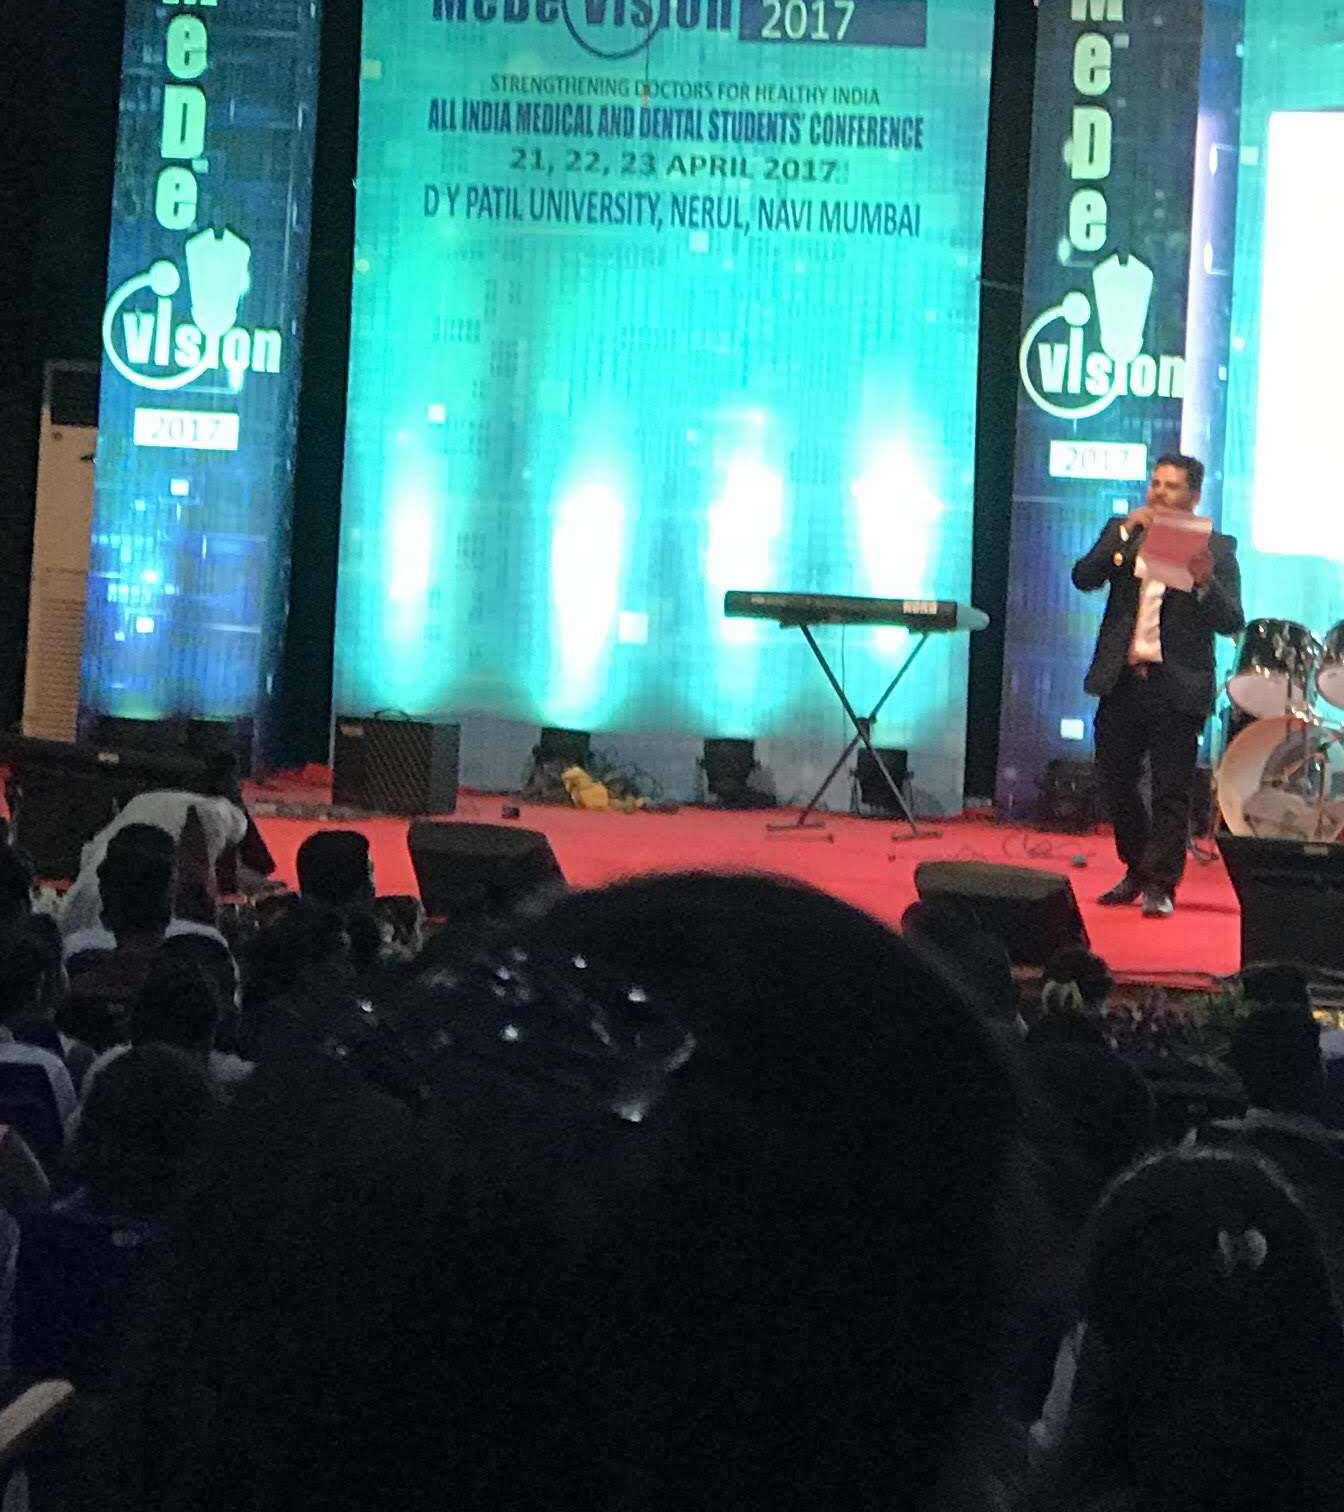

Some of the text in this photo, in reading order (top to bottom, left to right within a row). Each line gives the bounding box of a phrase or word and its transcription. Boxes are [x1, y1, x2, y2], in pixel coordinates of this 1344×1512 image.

[491, 73, 881, 107] STRENGTHENING DOCTORS FOR HEALTHY INDIA
[428, 97, 457, 132] ALL
[462, 99, 512, 134] INDIA
[516, 101, 594, 138] MEDICAL
[597, 104, 635, 139] AND
[639, 105, 704, 141] DENTAL
[809, 111, 925, 150] CONFERENCE
[511, 146, 840, 182] 21, 22, 23 APRIL 2017
[424, 184, 921, 238] D Y PATIL UNIVERSITY, NERUL, NAVI MUMBAI
